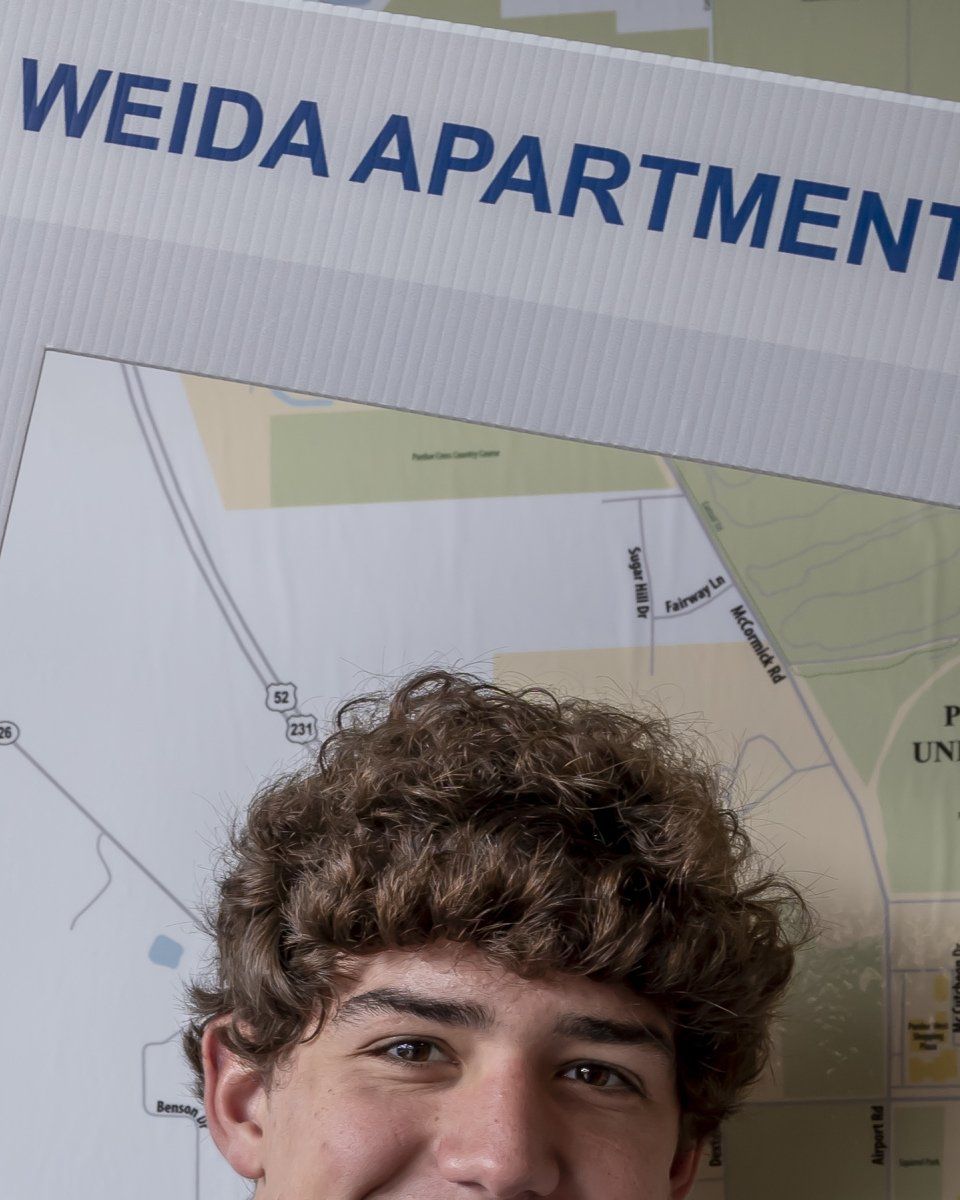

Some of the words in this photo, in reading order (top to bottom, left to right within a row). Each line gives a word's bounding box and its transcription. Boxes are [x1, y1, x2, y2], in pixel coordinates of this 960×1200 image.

[20, 57, 330, 179] WEIDA
[350, 114, 960, 282] APARTMENT
[628, 546, 644, 582] Sugar
[634, 582, 650, 604] Hill
[665, 584, 712, 613] Fairway
[708, 575, 726, 590] Ln
[636, 604, 650, 619] Dr
[730, 604, 775, 668] McCormick
[767, 665, 787, 685] Rd
[274, 691, 290, 704] 52
[290, 723, 313, 736] 231
[157, 1100, 198, 1118] Benson
[870, 1105, 884, 1121] Rd
[871, 1123, 888, 1166] Airport
